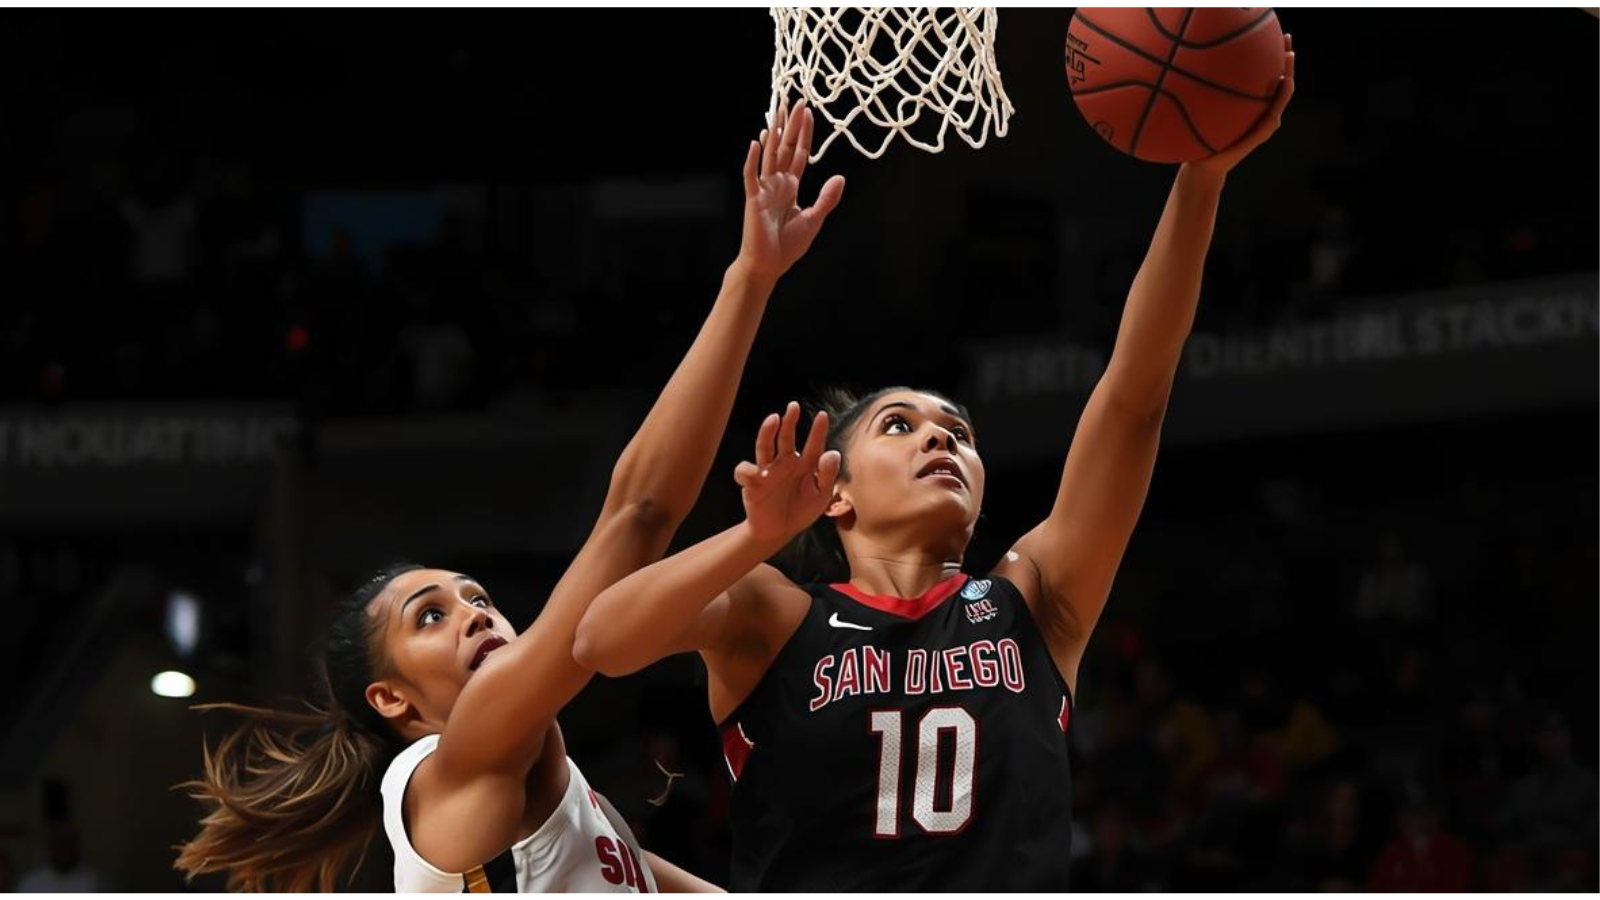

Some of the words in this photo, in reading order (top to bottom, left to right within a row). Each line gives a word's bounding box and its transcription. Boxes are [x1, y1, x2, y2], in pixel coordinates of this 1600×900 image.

[810, 645, 891, 711] SAN
[904, 637, 1026, 693] DIEGO
[868, 706, 978, 839] 10
